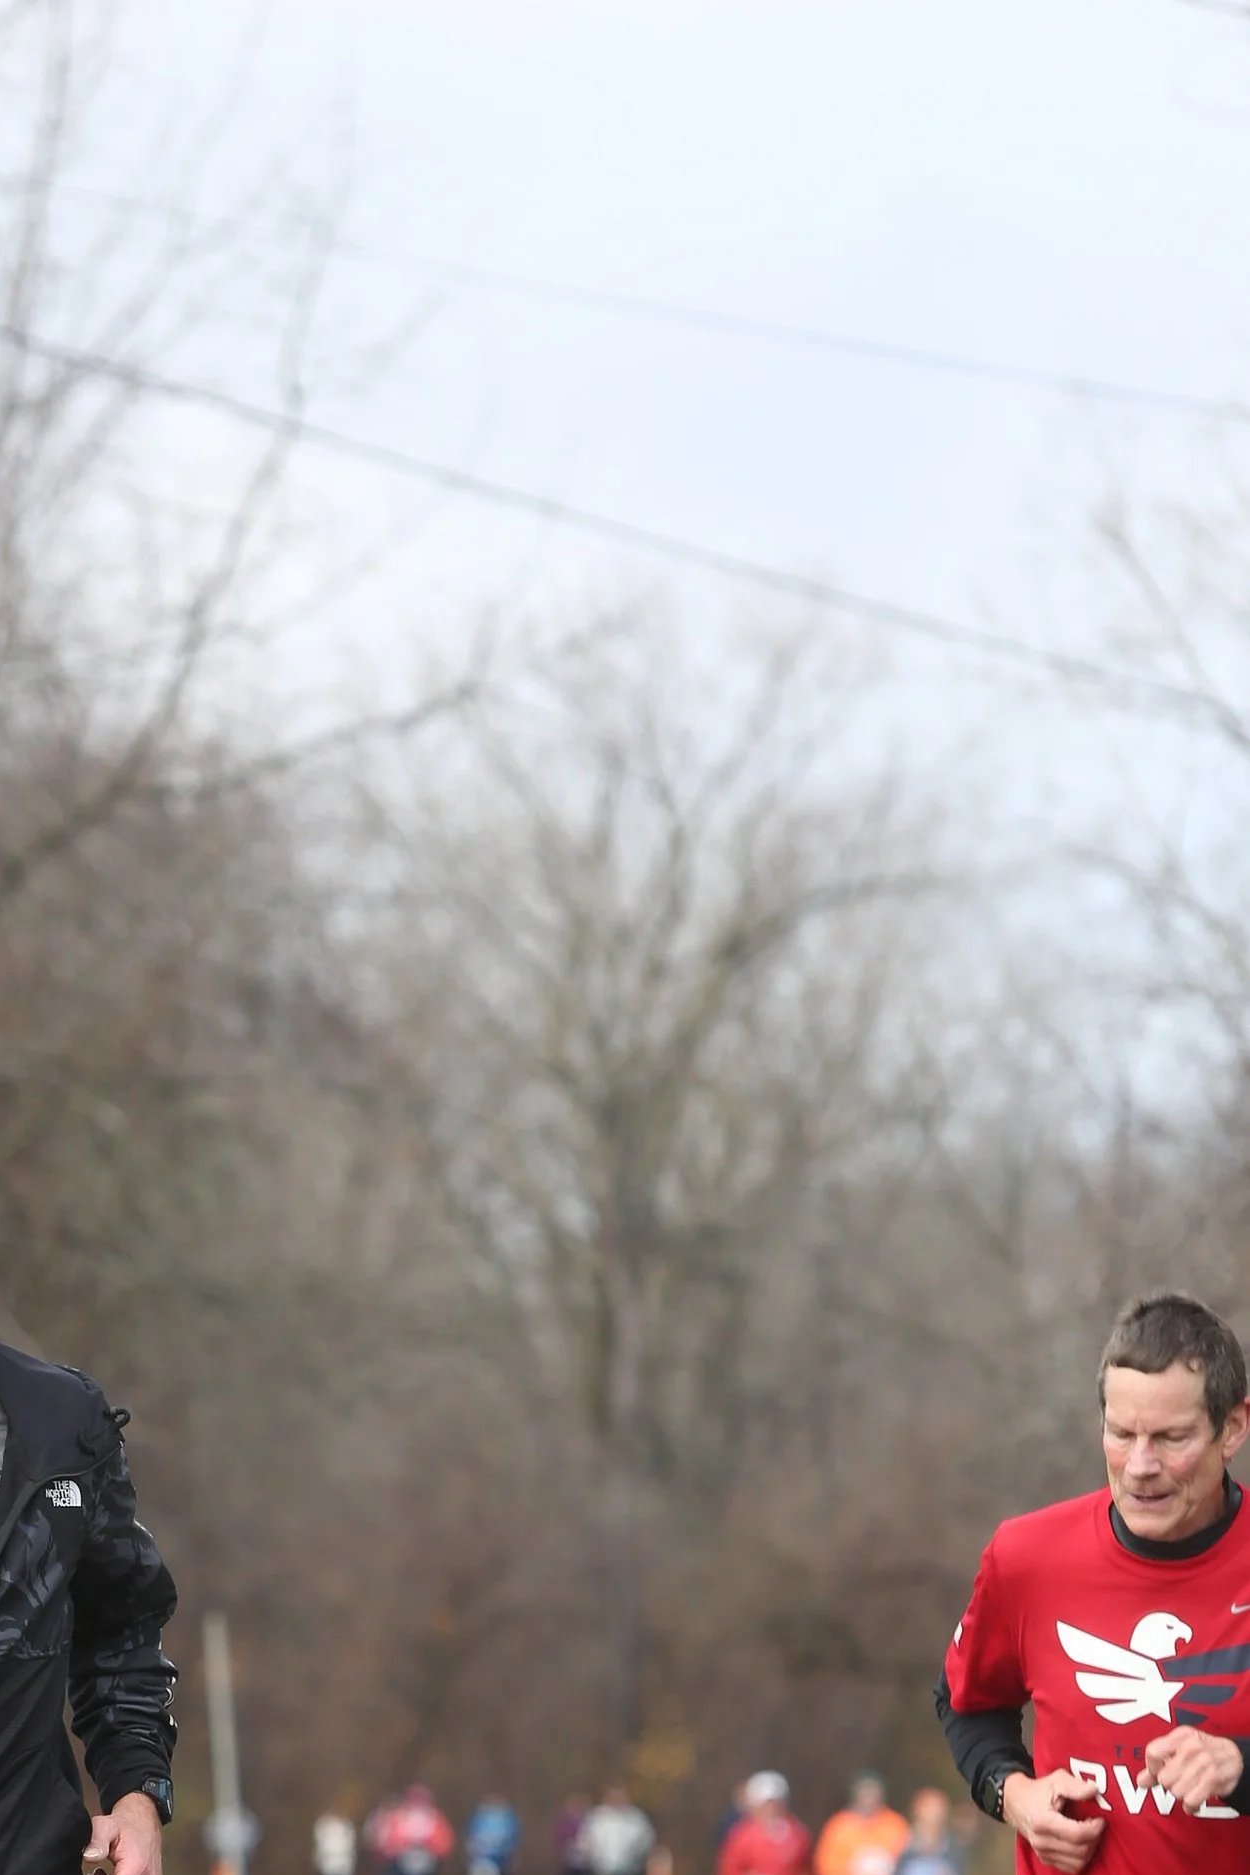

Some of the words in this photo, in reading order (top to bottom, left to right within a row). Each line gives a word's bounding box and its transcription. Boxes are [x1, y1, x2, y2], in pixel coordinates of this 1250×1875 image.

[53, 1480, 69, 1489] THE
[46, 1489, 70, 1498] NORTH
[53, 1497, 71, 1506] FACE
